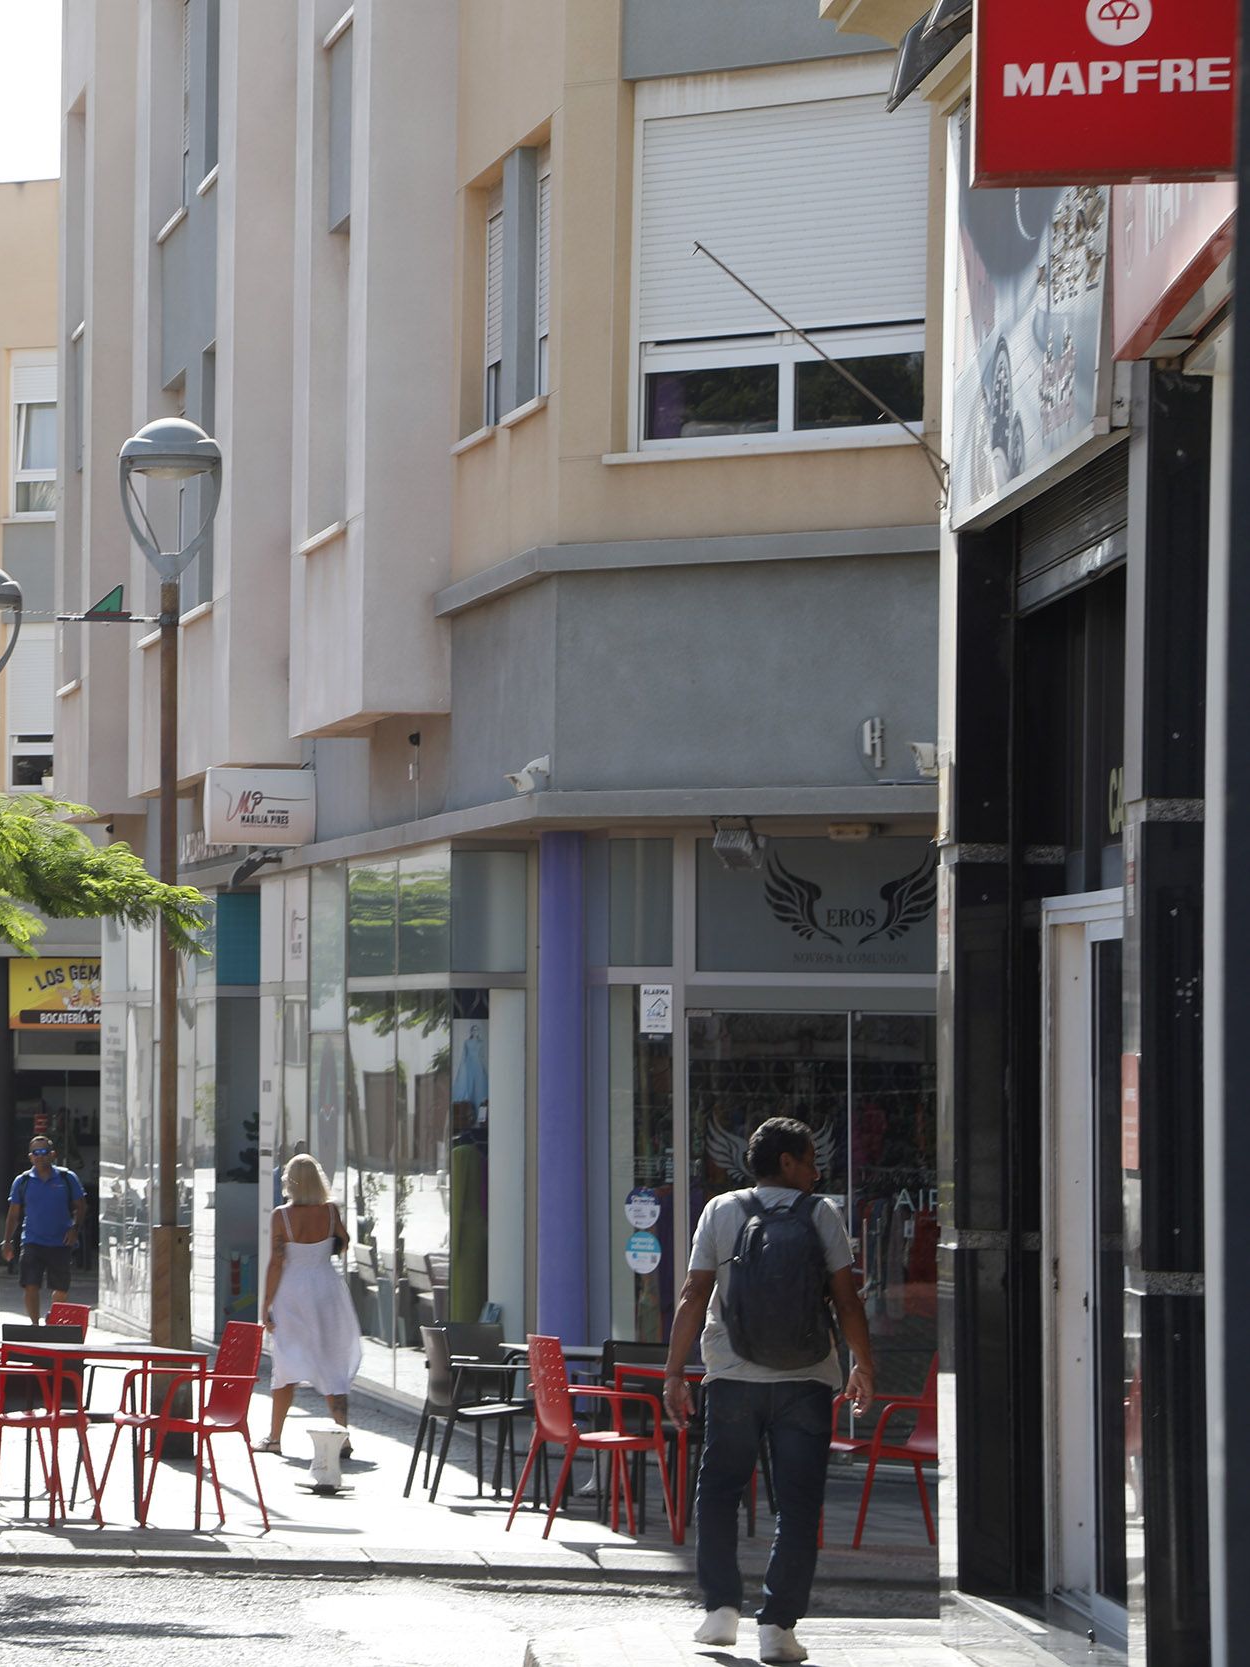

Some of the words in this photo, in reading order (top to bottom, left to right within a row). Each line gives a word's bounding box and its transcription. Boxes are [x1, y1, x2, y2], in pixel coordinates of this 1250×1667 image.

[1003, 57, 1231, 97] MAPFRE
[826, 909, 877, 928] EROS
[793, 952, 833, 964] NOVIOS
[35, 966, 65, 990] LOS
[40, 1010, 88, 1024] BOCATERÍA
